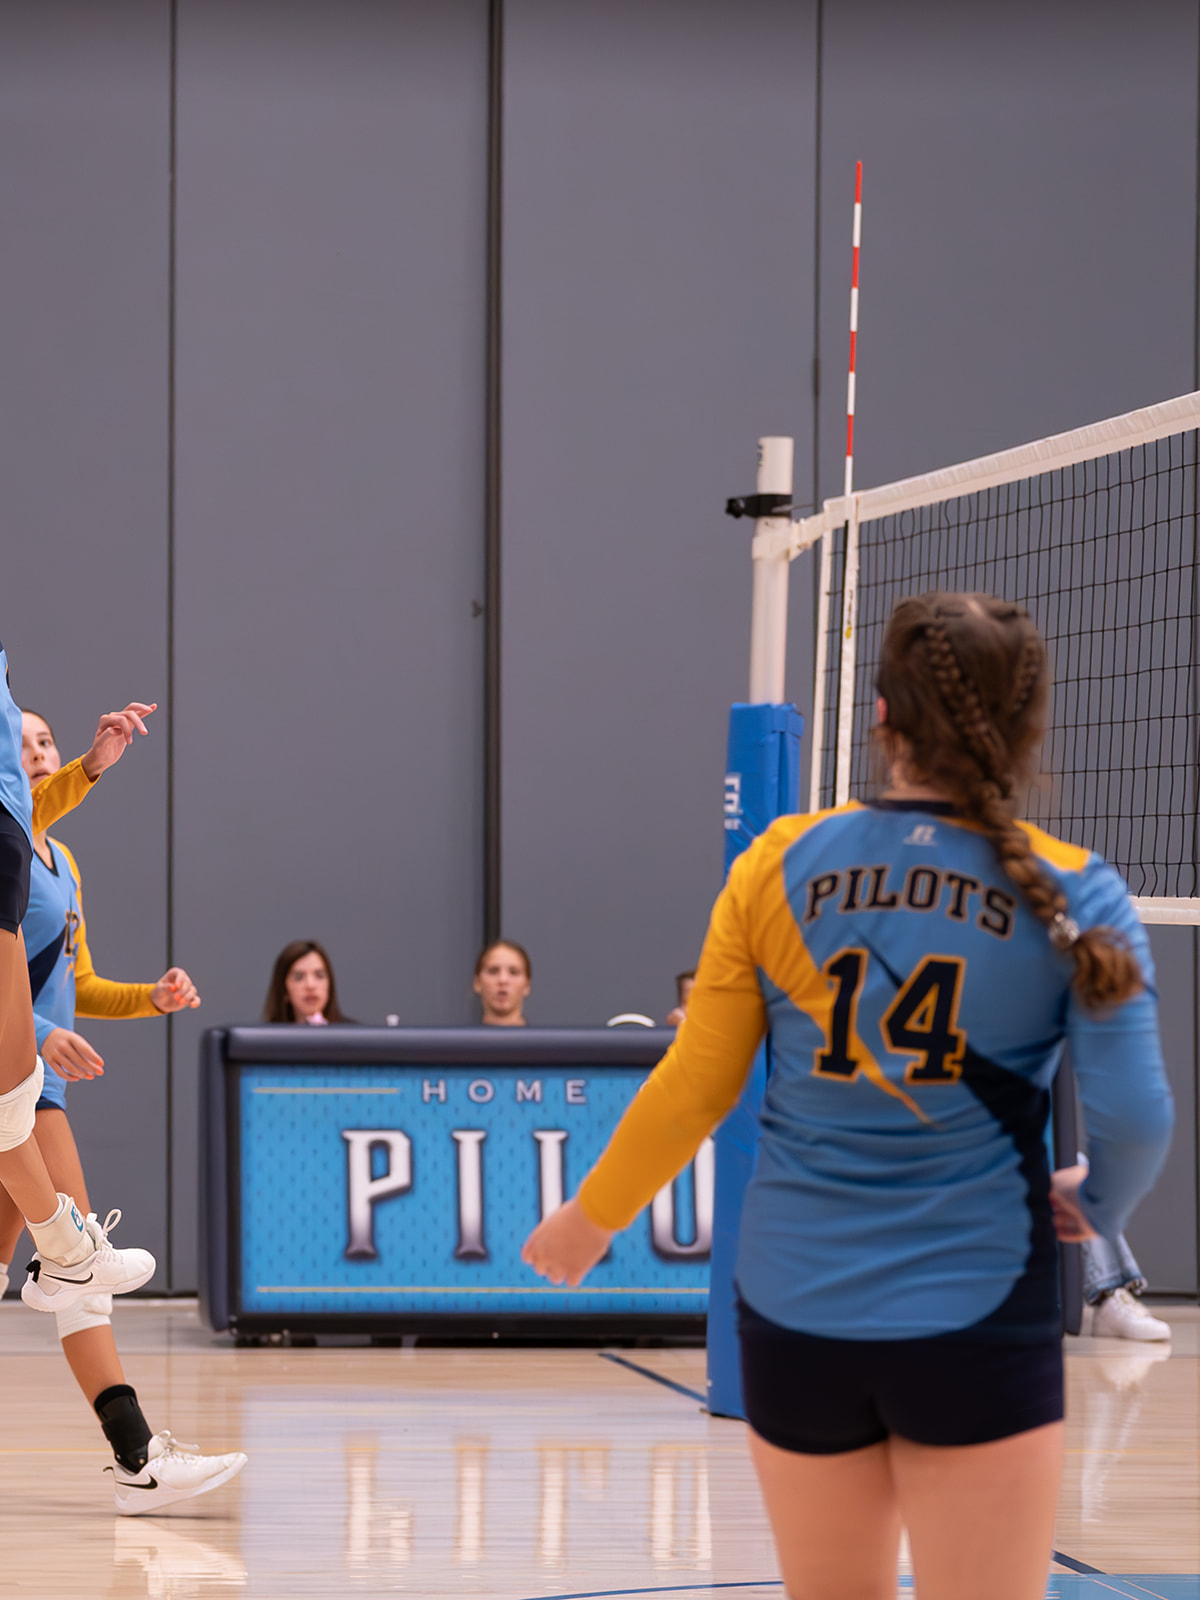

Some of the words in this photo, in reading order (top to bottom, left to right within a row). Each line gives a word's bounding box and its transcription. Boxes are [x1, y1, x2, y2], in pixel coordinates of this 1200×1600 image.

[802, 865, 1019, 940] PILOTS
[812, 946, 967, 1086] 14
[421, 1078, 588, 1104] HOME
